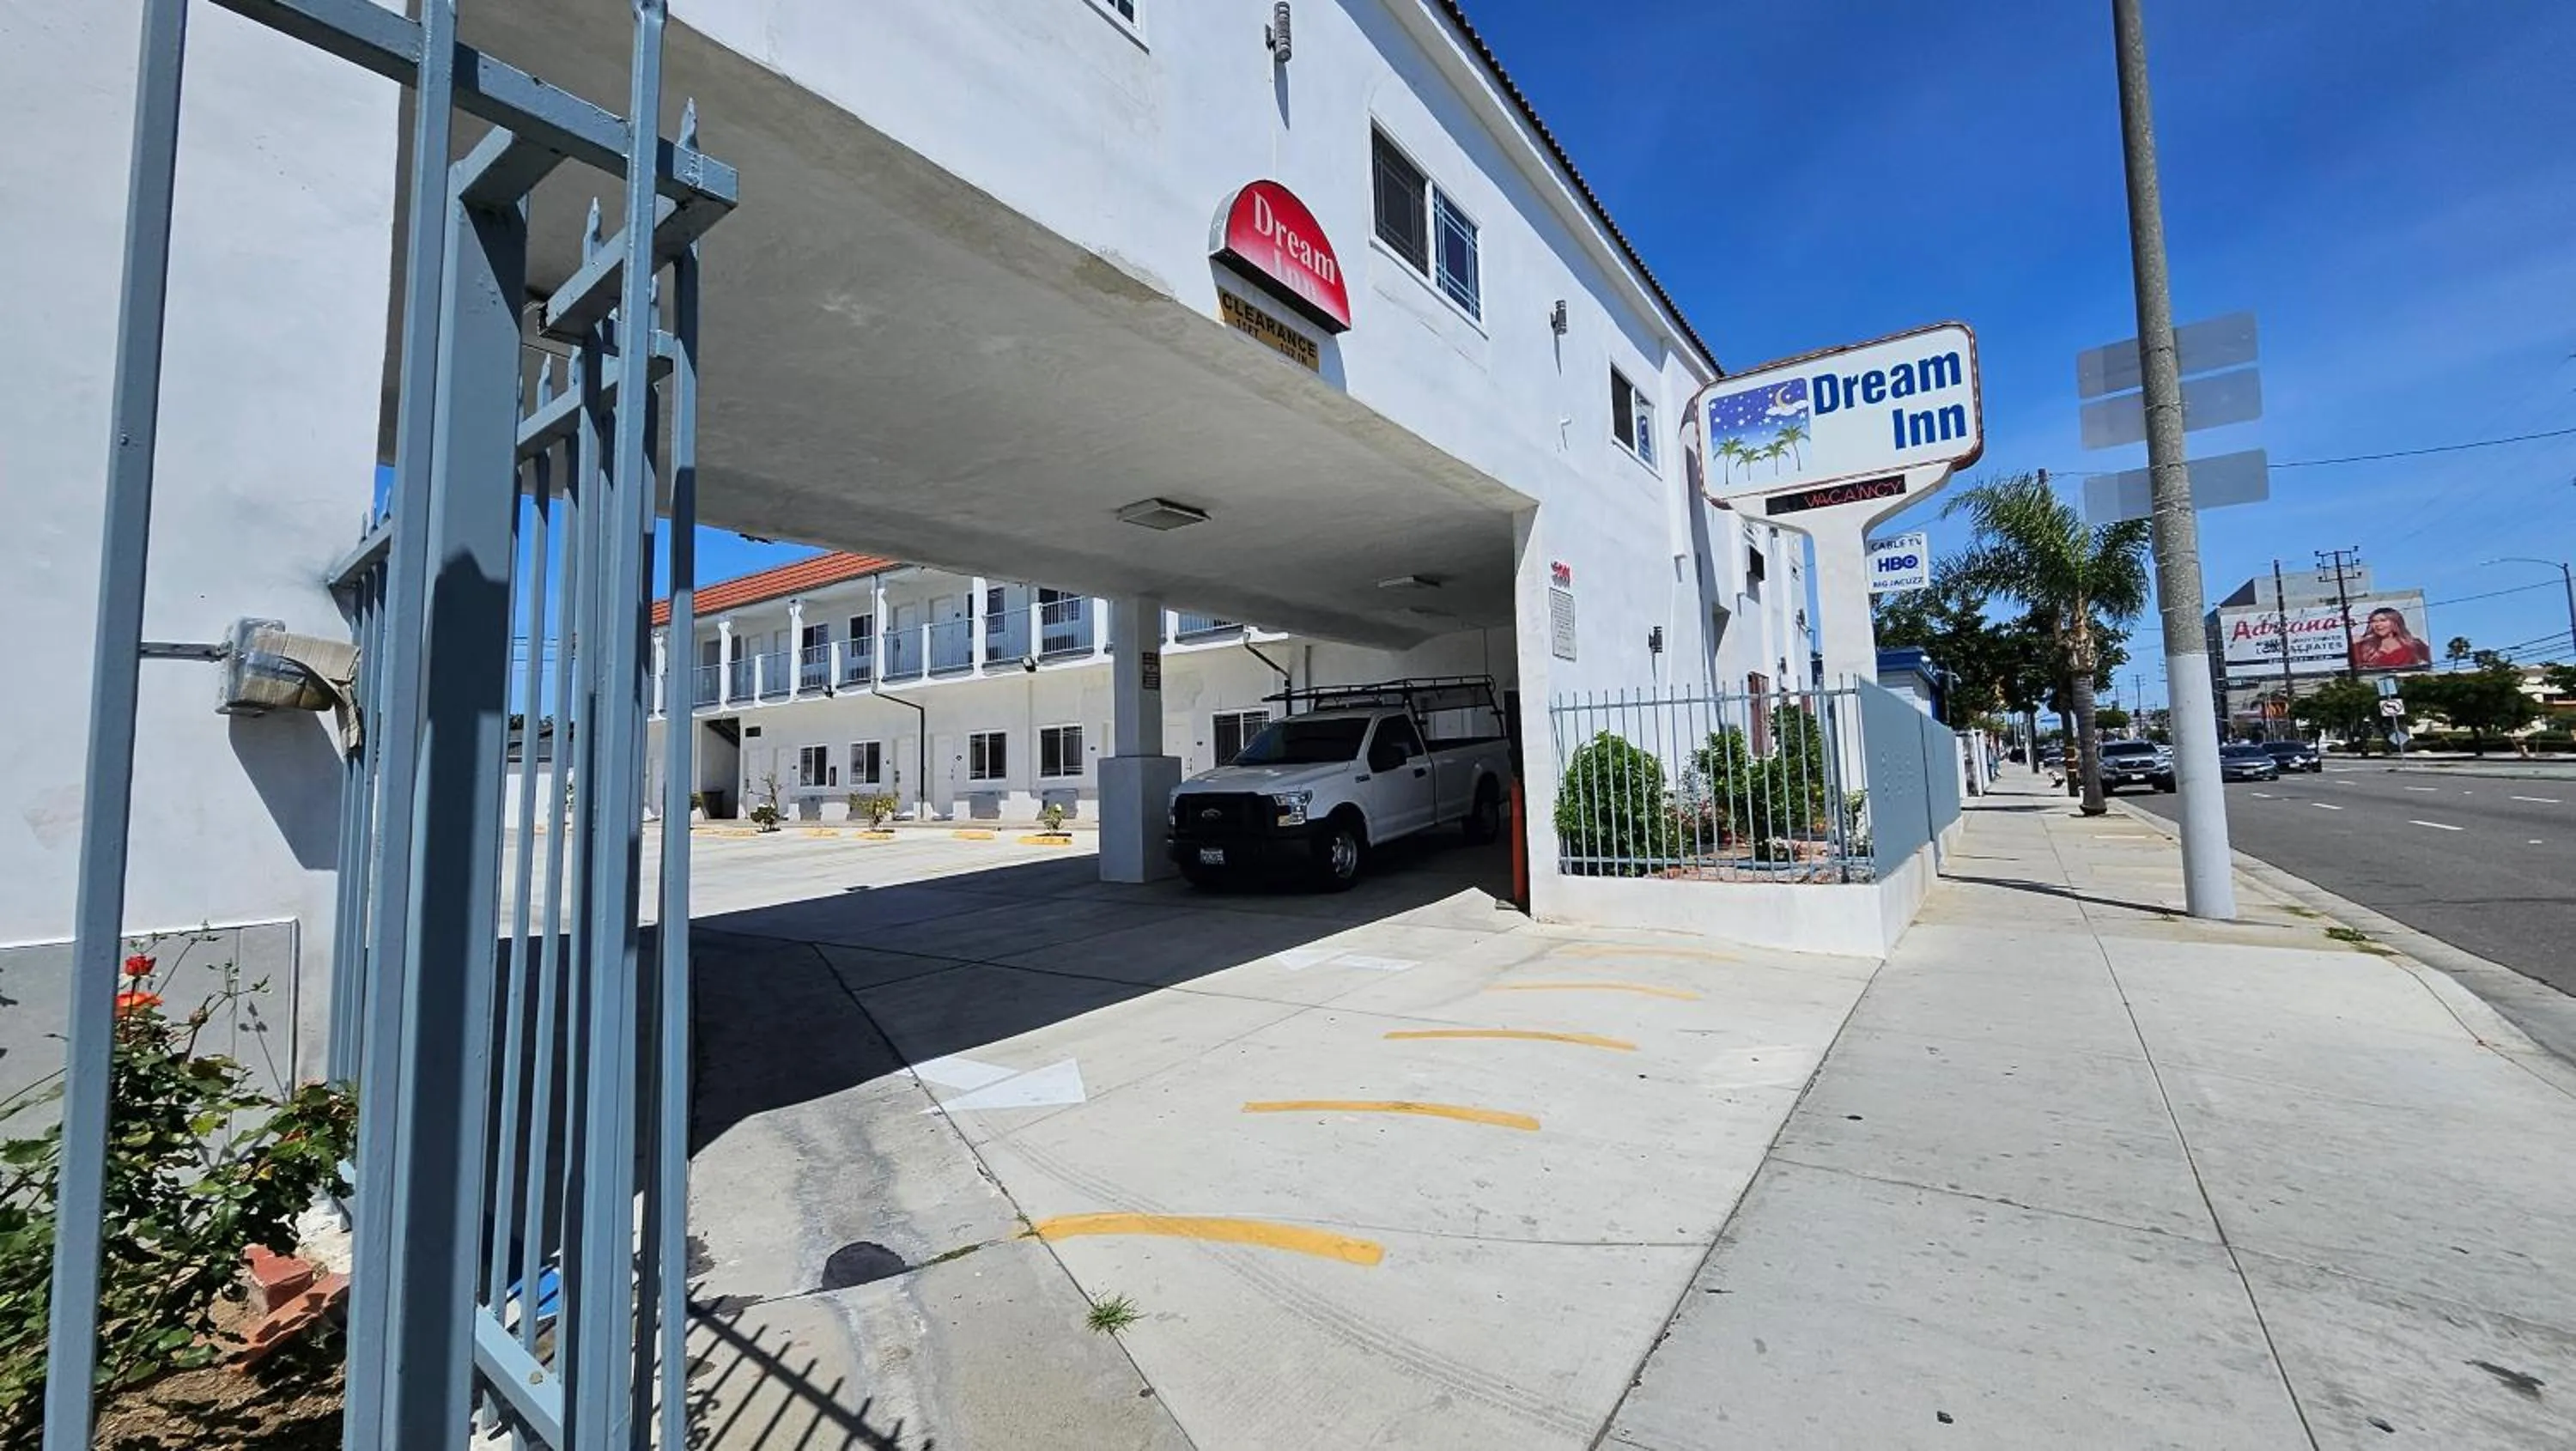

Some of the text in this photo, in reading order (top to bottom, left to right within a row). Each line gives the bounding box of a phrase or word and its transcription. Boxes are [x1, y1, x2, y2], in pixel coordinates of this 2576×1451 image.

[1253, 191, 1335, 285] Dream
[1273, 248, 1317, 297] Inn
[1221, 291, 1317, 359] CLEARANCE
[1812, 350, 1962, 416] Dream
[1892, 404, 1967, 451] Inn
[1803, 480, 1902, 508] VACANCY
[1871, 538, 1905, 552] CABLE
[1877, 554, 1919, 573] HBO
